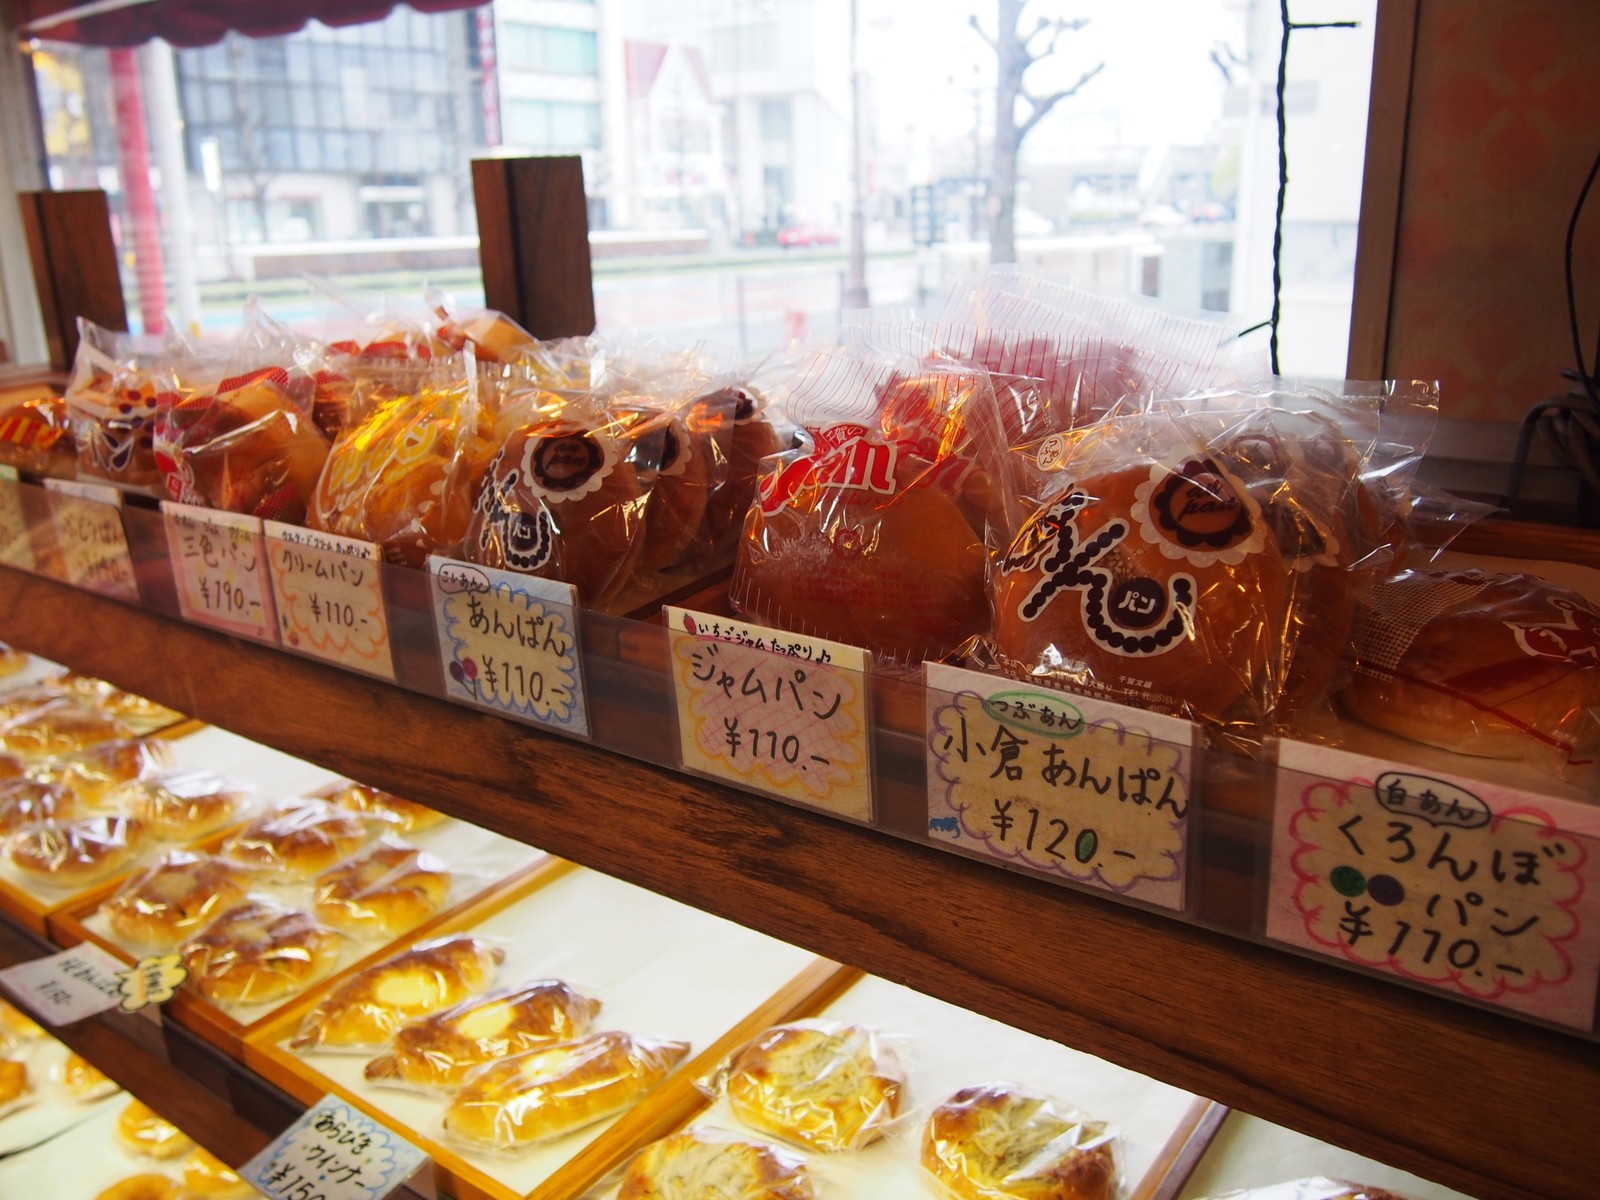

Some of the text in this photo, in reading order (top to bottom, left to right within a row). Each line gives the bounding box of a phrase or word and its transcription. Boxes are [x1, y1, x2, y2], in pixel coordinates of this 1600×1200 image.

[183, 533, 256, 573] 三色パン
[282, 549, 364, 588] クリームパン
[1117, 590, 1157, 614] パン
[466, 595, 566, 658] あんぱん
[691, 643, 842, 720] ジャムパン
[990, 699, 1083, 731] つぶあん
[943, 716, 1189, 819] 小倉あんぱん
[1387, 778, 1476, 822] 白あん
[1337, 814, 1566, 886] くろんぼ
[1425, 890, 1540, 937] パン
[314, 1110, 373, 1155] あらびき
